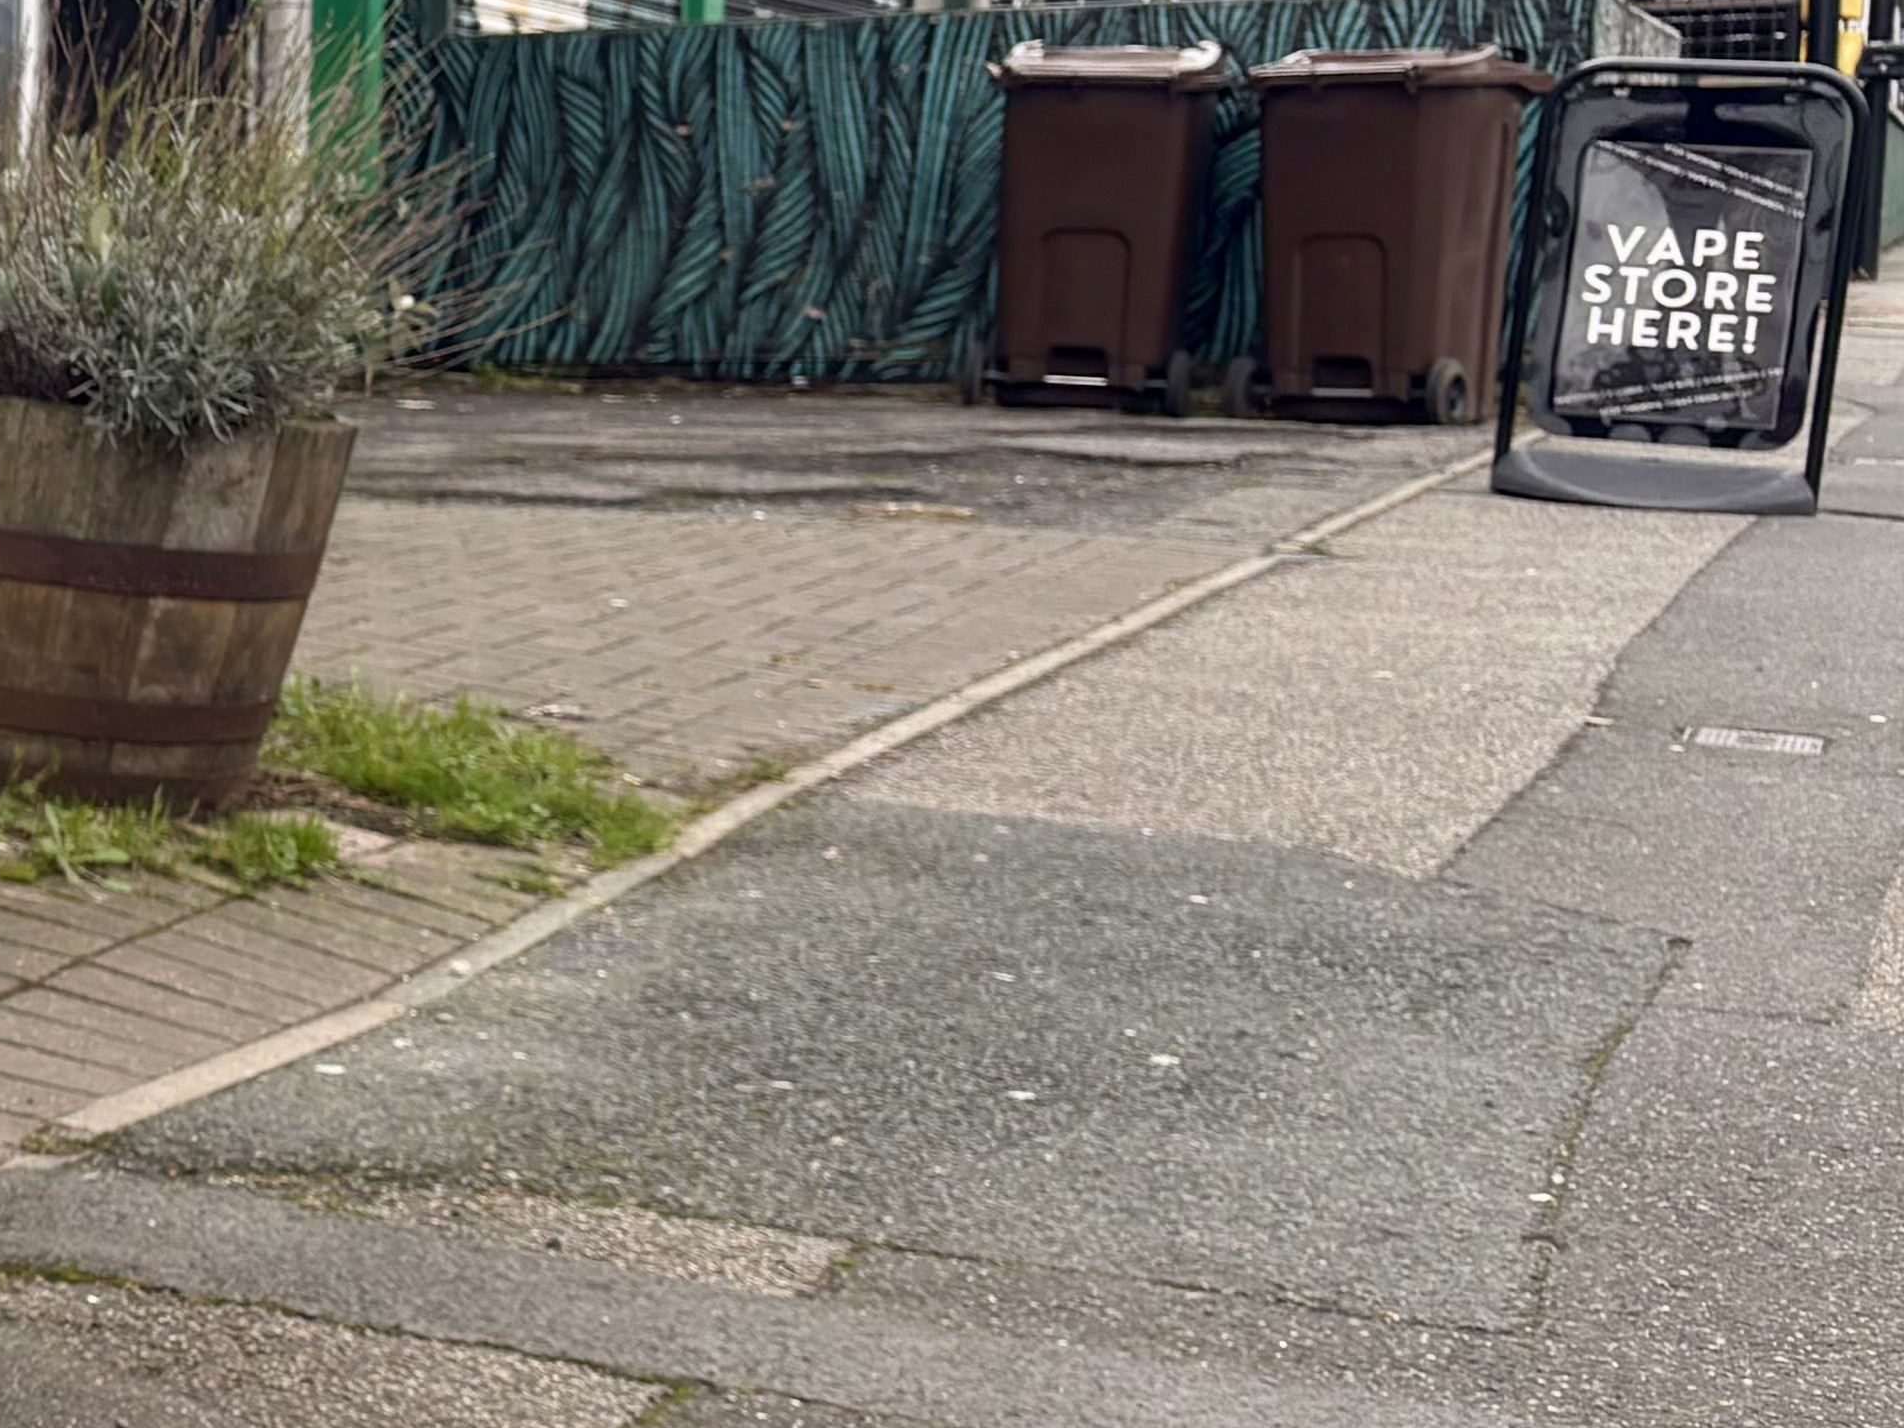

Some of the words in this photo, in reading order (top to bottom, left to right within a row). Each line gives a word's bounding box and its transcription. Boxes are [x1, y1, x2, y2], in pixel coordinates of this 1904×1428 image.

[1607, 223, 1765, 271] VAPE
[1581, 264, 1777, 314] STORE
[1586, 306, 1759, 354] HERE!
